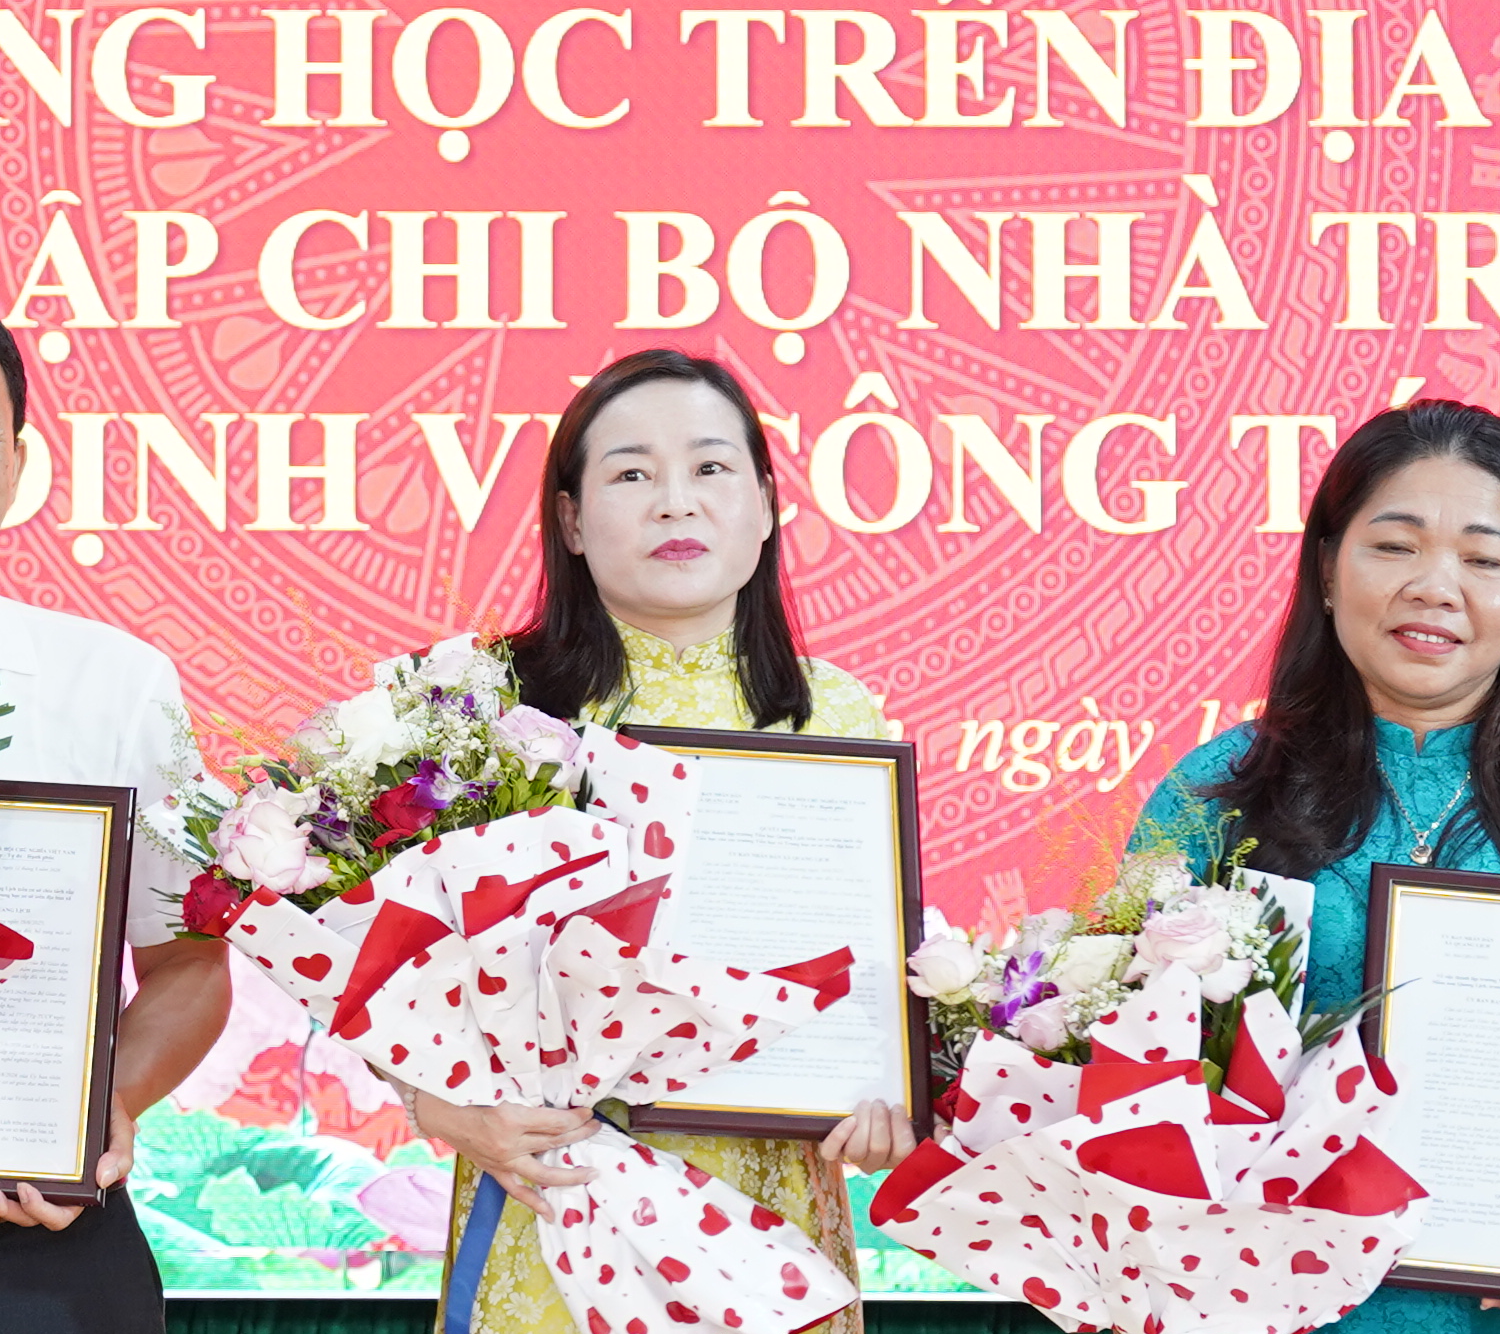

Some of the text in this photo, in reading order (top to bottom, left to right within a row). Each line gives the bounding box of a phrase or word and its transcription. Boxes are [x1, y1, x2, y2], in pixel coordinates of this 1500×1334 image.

[260, 7, 633, 163] HỌC
[1183, 8, 1493, 164] ĐỊA
[257, 209, 568, 331] CHI
[613, 189, 851, 366] BỘ
[896, 173, 1270, 331] NHÀ
[410, 373, 591, 534] V
[756, 370, 1190, 536] ÔNG
[955, 695, 1156, 794] ngày
[1197, 699, 1267, 746] 1
